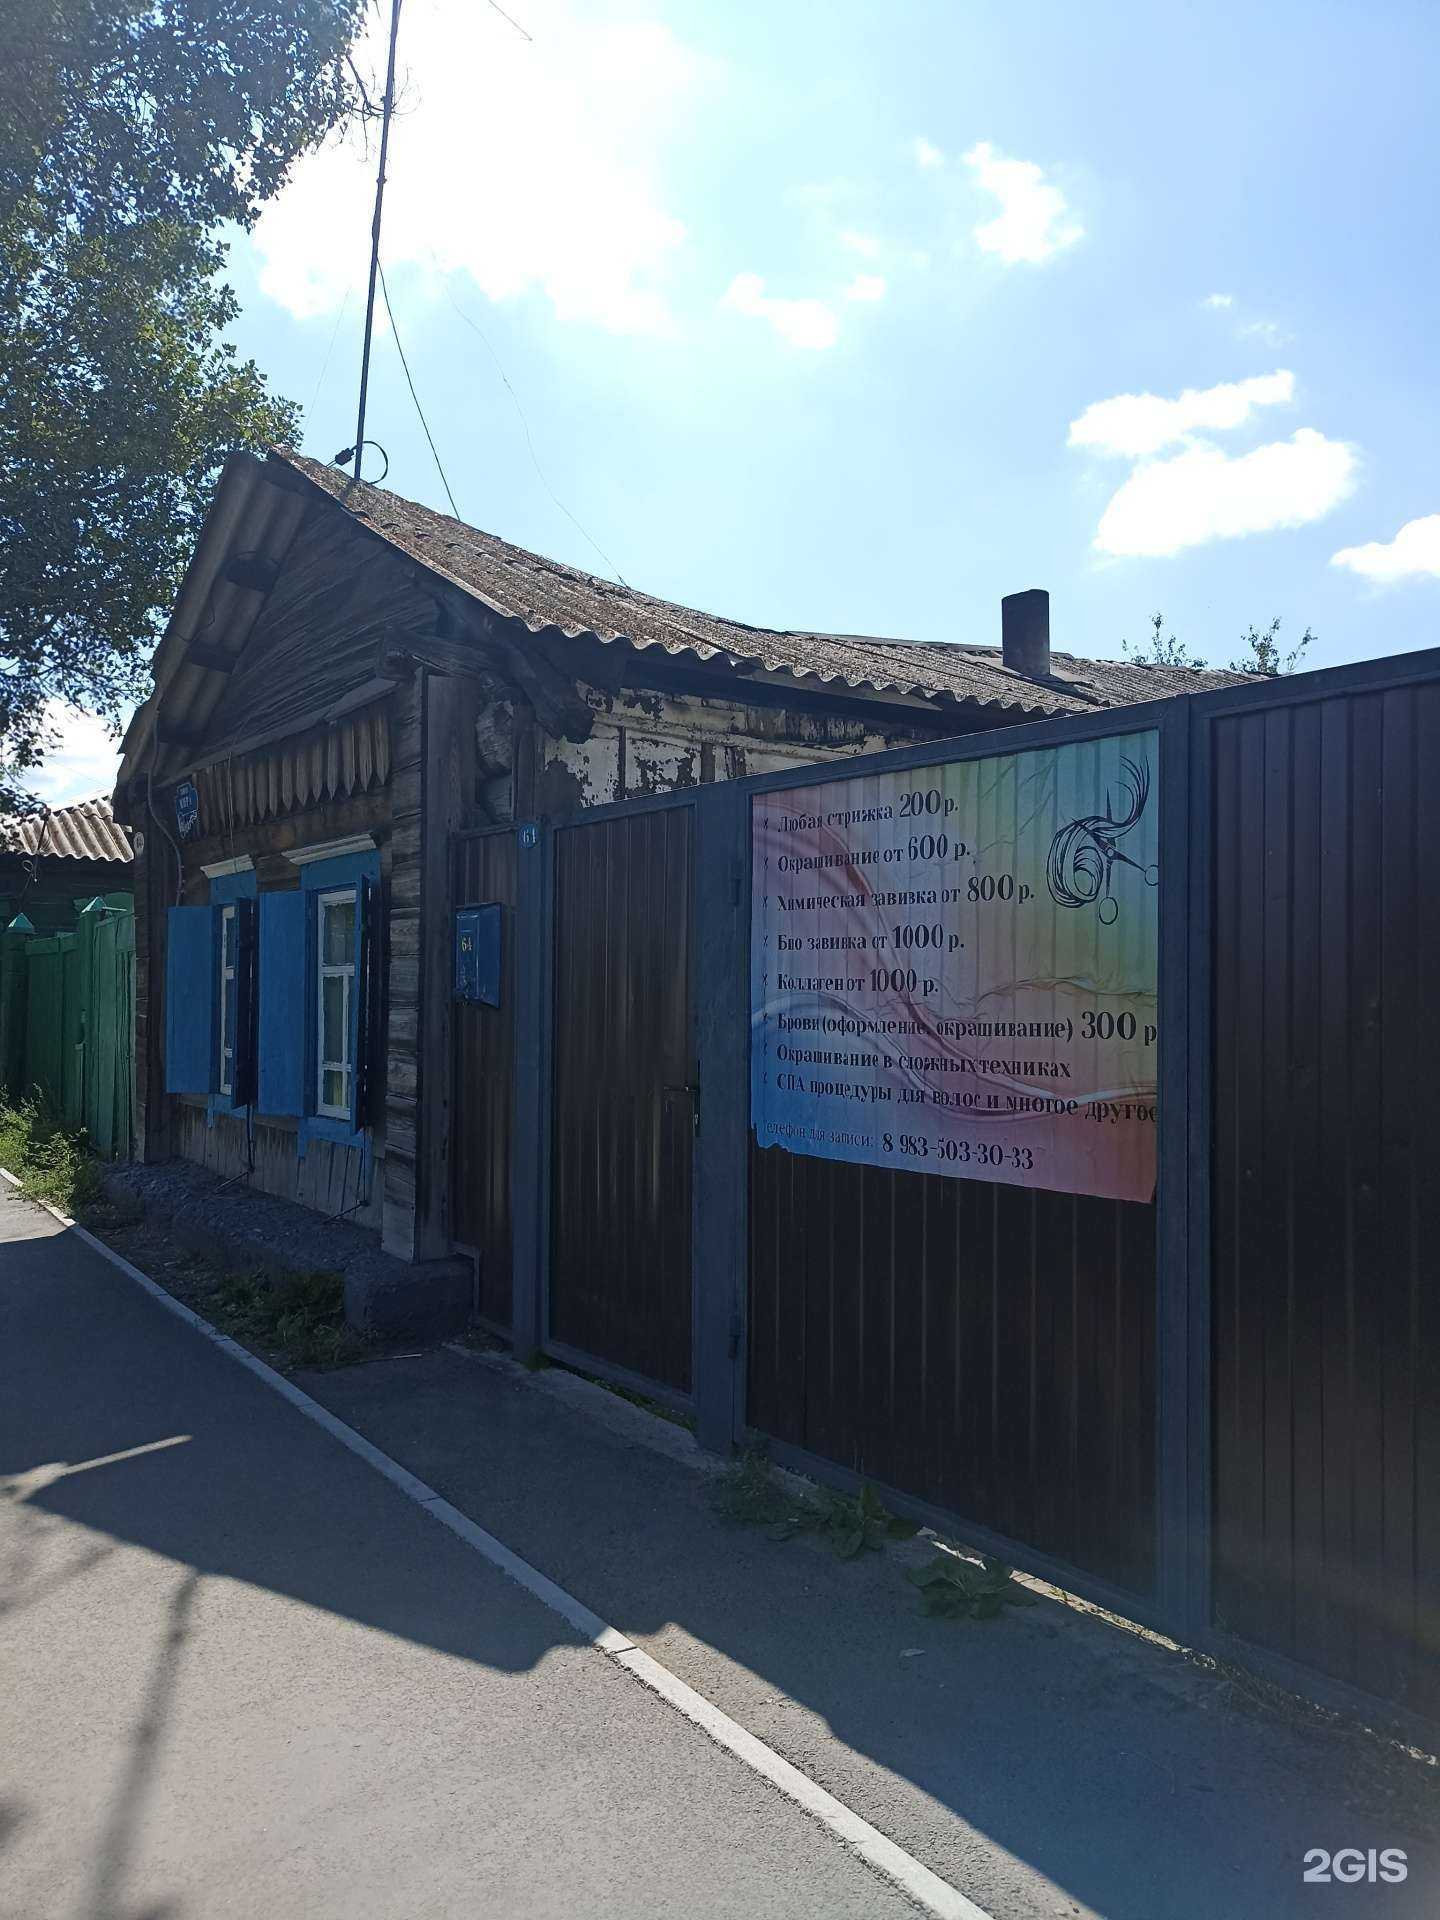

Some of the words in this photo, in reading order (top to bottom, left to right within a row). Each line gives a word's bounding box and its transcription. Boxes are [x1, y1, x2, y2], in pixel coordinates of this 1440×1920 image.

[777, 813, 823, 832] Любая
[827, 804, 893, 828] стрижка
[900, 789, 941, 817] 200
[944, 797, 959, 817] р.
[778, 849, 880, 875] Окрашивание
[883, 848, 904, 862] от
[908, 833, 948, 861] 600
[954, 841, 970, 861] р.
[777, 894, 865, 911] Химическая
[871, 889, 937, 907] завивка
[941, 888, 960, 903] от
[967, 874, 1014, 902] 800
[1018, 882, 1035, 904] р.
[777, 934, 802, 951] Био
[808, 935, 867, 950] завивка
[872, 936, 888, 950] от
[892, 924, 944, 949] 1000
[948, 932, 965, 952] р.
[777, 973, 844, 991] Коллаген
[846, 976, 865, 992] от
[870, 968, 917, 992] 1000
[923, 978, 939, 996] р.
[777, 1013, 819, 1032] Брови
[936, 1017, 1073, 1042] окрашивание)
[1081, 1011, 1137, 1041] 300
[777, 1044, 879, 1068] Окрашивание
[883, 1055, 893, 1069] в
[898, 1055, 977, 1074] сложных
[978, 1059, 1072, 1078] техниках
[777, 1073, 806, 1092] СПА
[810, 1079, 892, 1103] процедуры
[897, 1087, 926, 1104] для
[932, 1090, 980, 1108] волос
[987, 1094, 999, 1109] и
[1006, 1096, 1079, 1116] многое
[765, 1119, 805, 1138] елефон
[882, 1132, 894, 1153] 8
[899, 1134, 1034, 1170] 983-503-30-33
